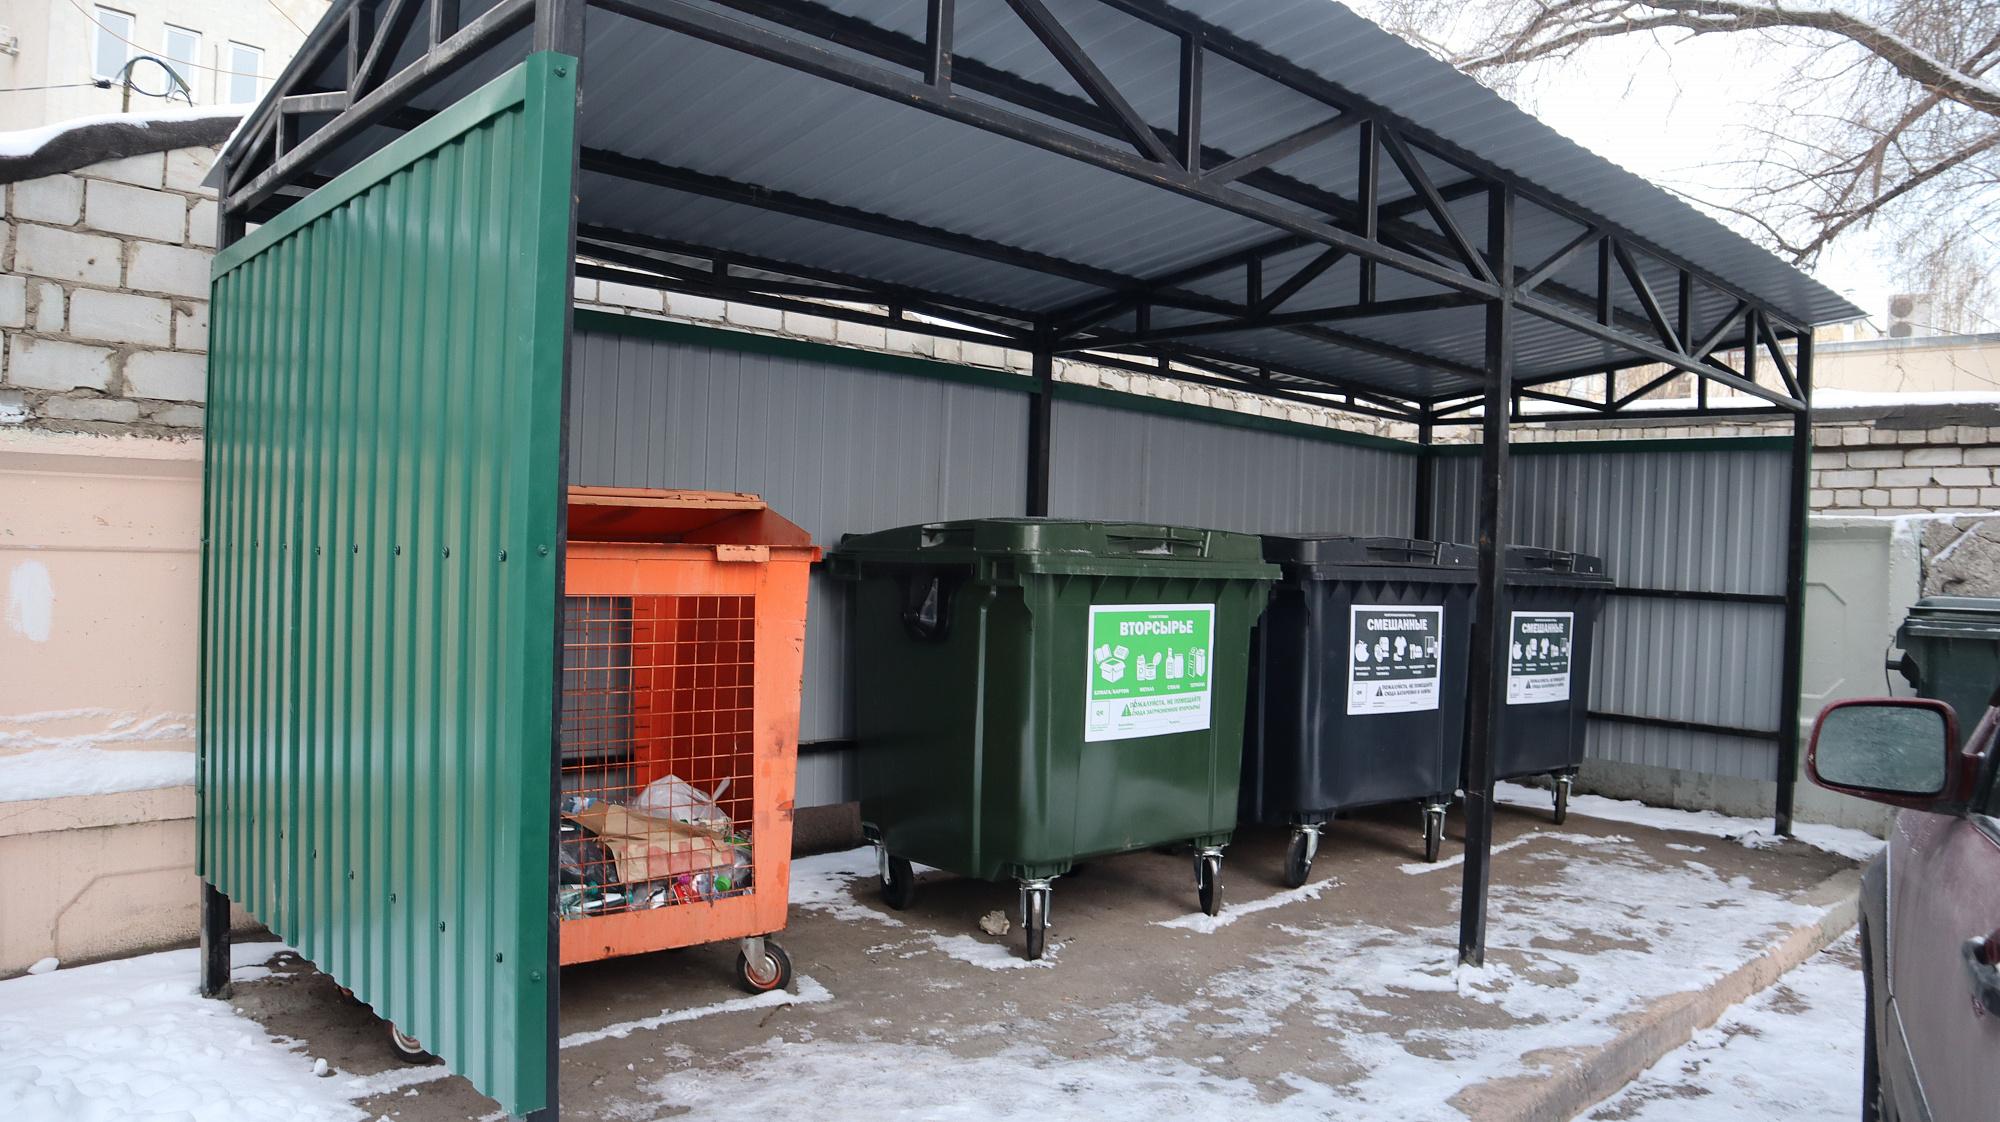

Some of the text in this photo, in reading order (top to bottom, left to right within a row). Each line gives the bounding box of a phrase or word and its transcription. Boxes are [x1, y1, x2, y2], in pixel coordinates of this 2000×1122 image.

[1120, 620, 1194, 636] ВТОРСЫРЬЕ
[1367, 618, 1428, 631] СМЕШАННЫЕ
[1521, 623, 1564, 634] СМЕШАННЫЕ
